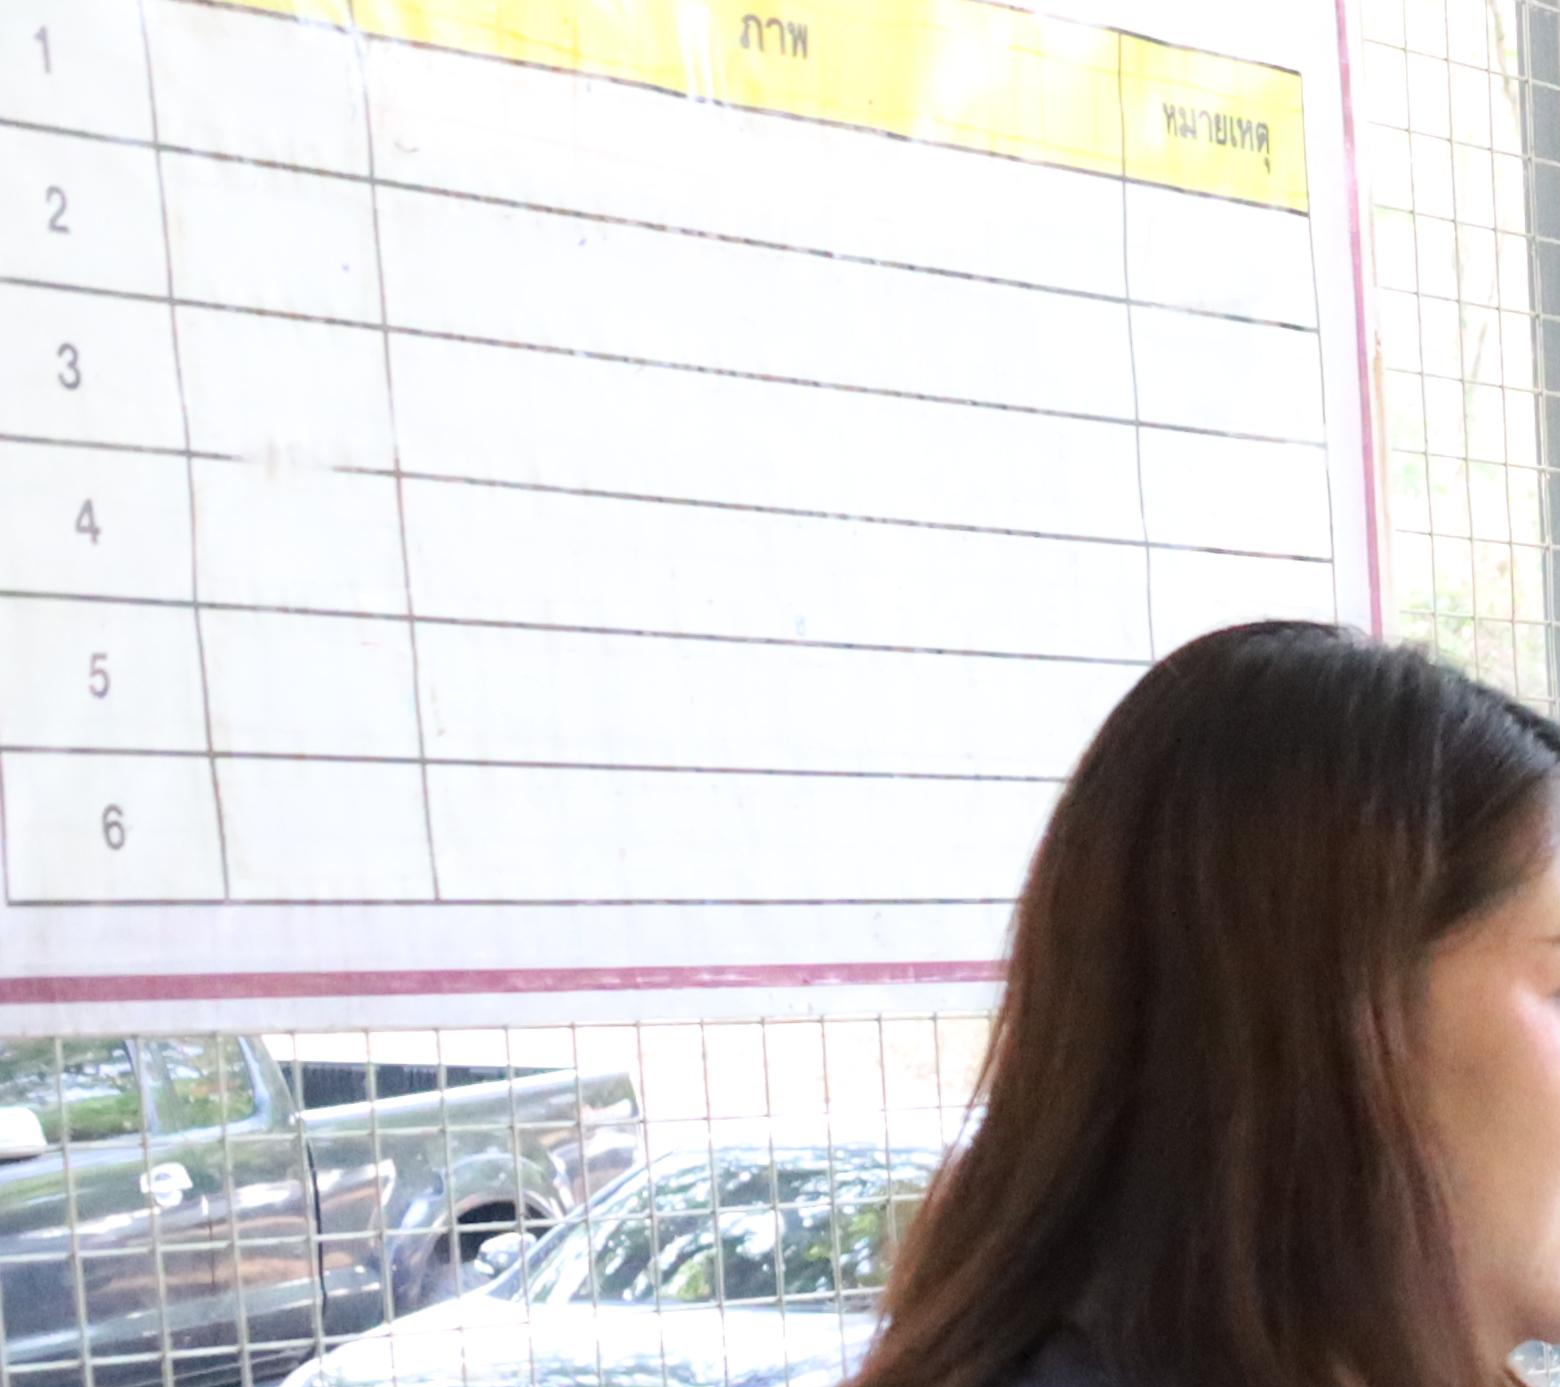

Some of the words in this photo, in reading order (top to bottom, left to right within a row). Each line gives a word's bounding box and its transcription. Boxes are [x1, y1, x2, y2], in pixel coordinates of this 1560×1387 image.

[34, 26, 51, 73] 1
[740, 13, 808, 60] ภาพ
[1161, 101, 1271, 175] หมายเหตุ
[46, 186, 70, 234] 2
[57, 343, 82, 390] 3
[75, 498, 101, 545] 4
[88, 652, 110, 699] 5
[101, 804, 127, 851] 6
